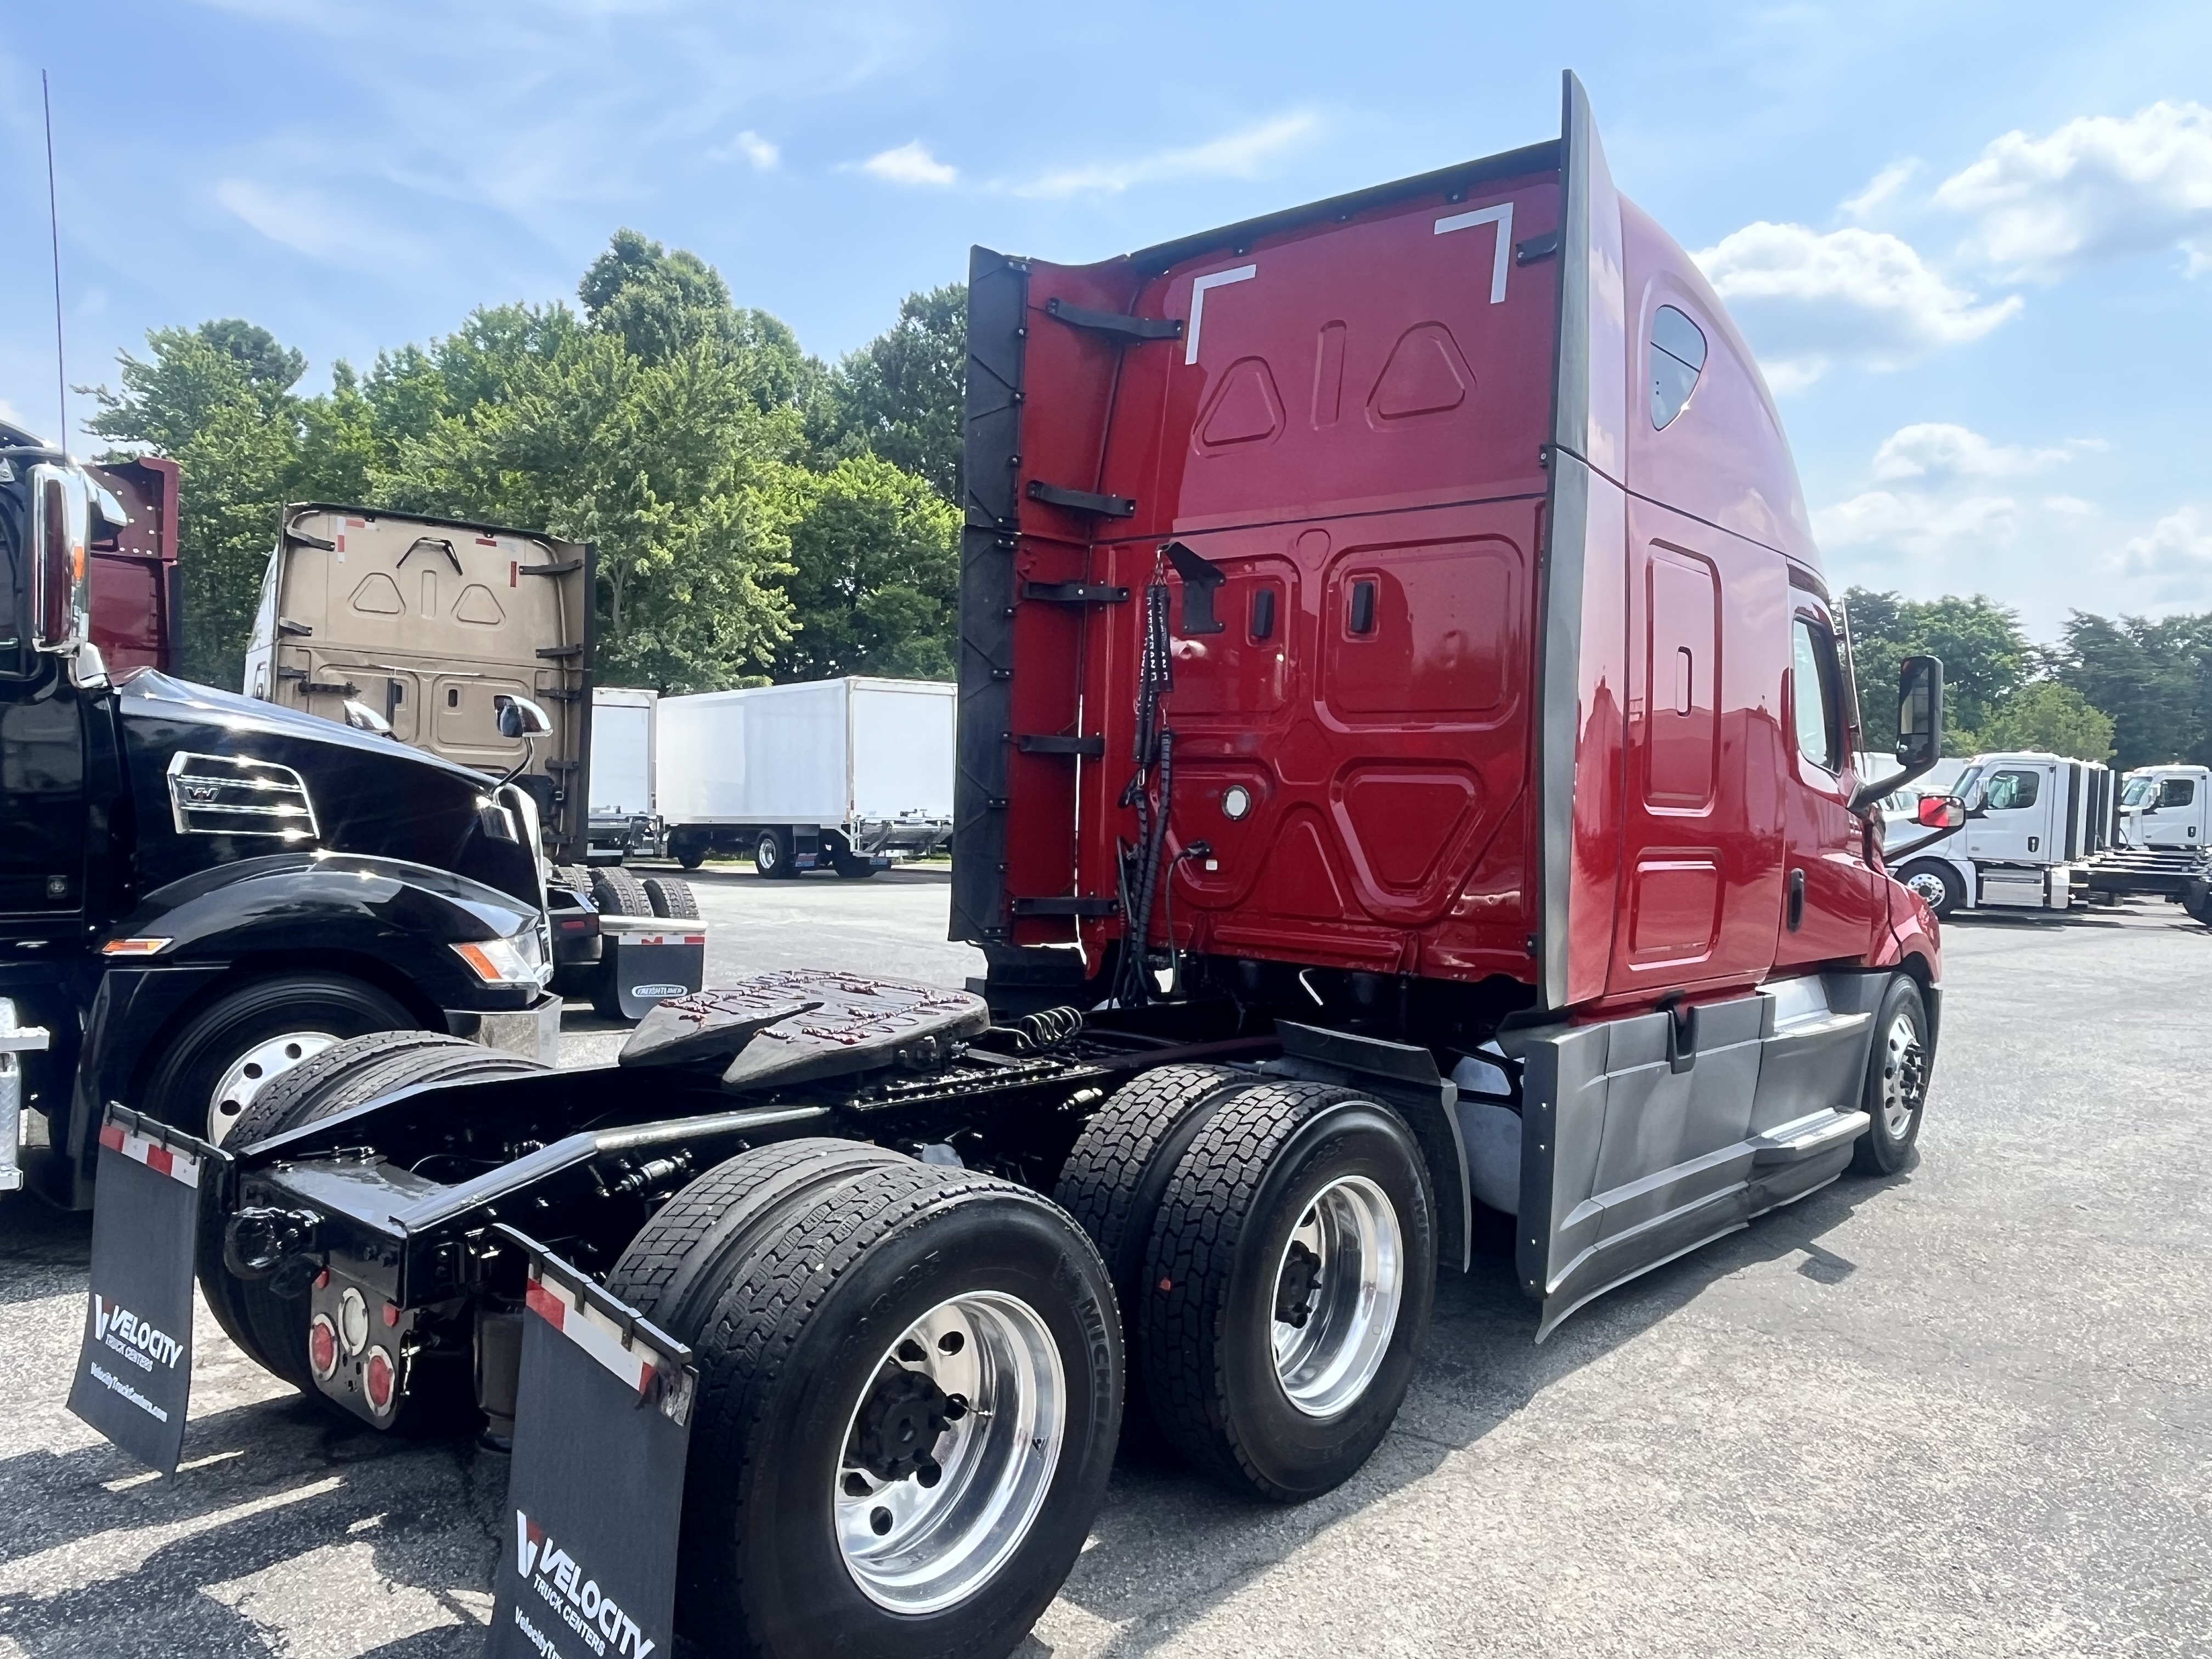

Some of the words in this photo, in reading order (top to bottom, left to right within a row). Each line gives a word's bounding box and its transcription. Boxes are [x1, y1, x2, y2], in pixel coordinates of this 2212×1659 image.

[110, 1305, 184, 1369] VELOCITY
[533, 1573, 564, 1614] TRUCK
[562, 1605, 606, 1657] CENTERS
[539, 1537, 655, 1659] VELOCITY
